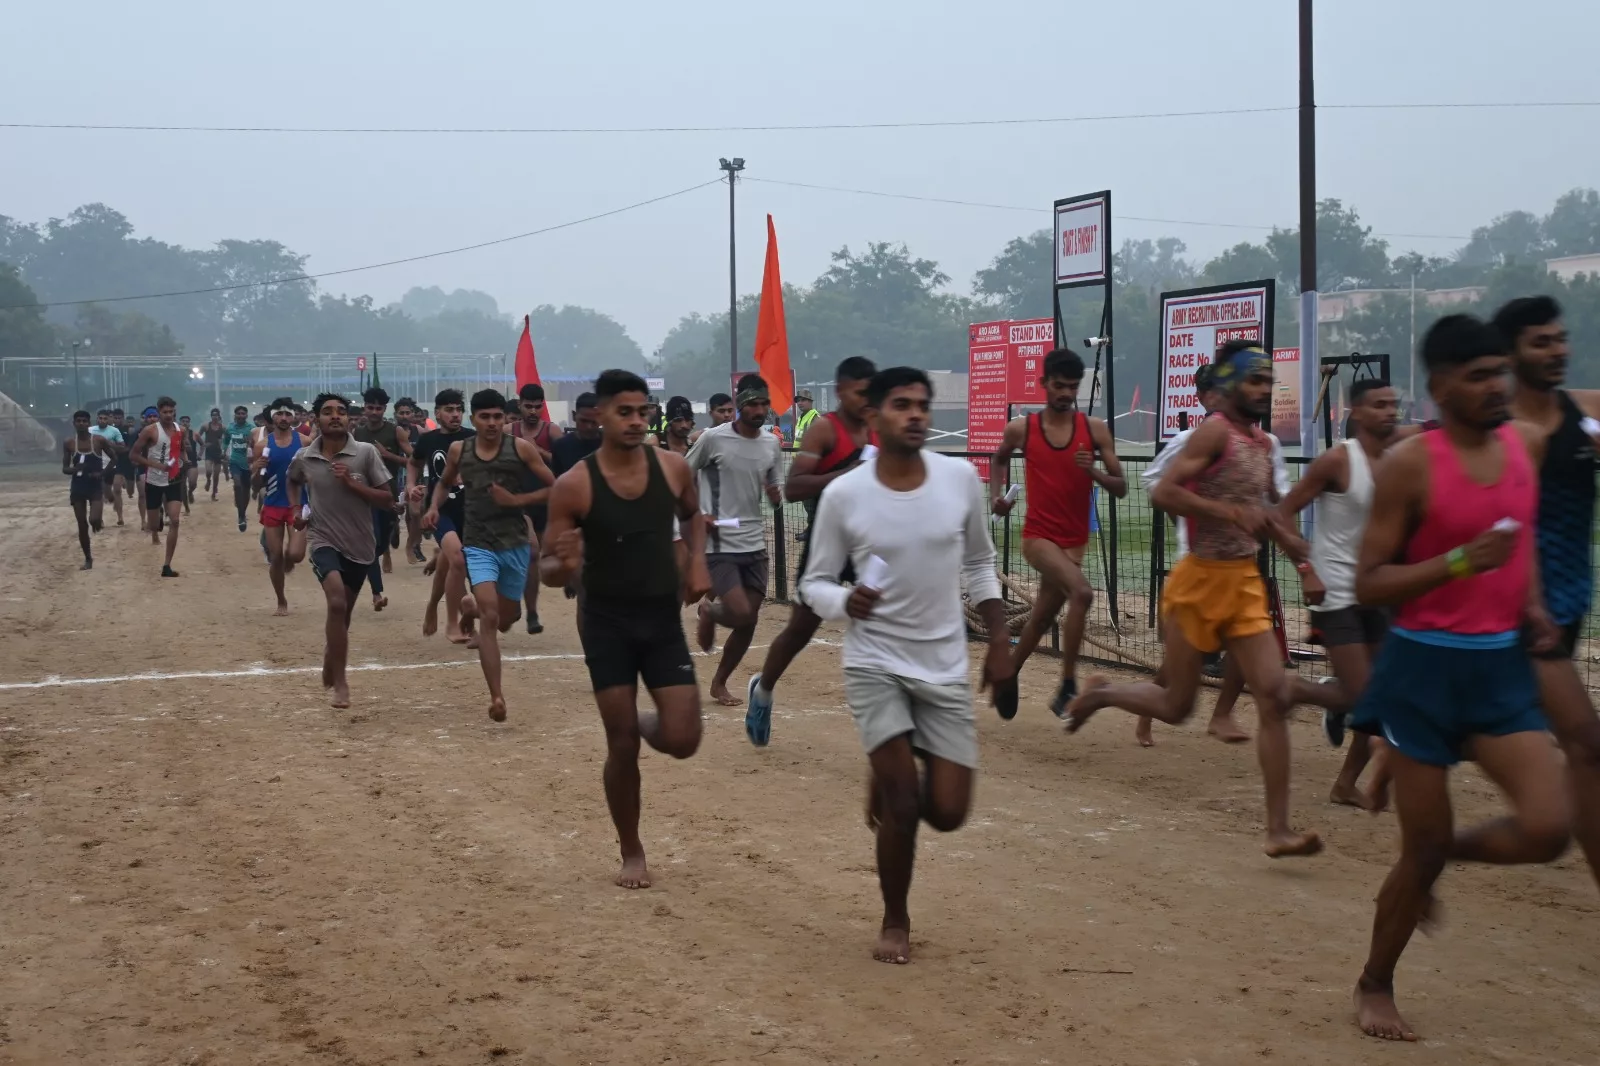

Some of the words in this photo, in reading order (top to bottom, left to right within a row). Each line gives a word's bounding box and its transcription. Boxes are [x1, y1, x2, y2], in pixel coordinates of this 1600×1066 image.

[1172, 308, 1187, 326] ARMY
[1188, 304, 1219, 324] RECRUITING
[1221, 303, 1239, 321] OFFICE
[1240, 300, 1256, 319] AGRA
[1011, 326, 1034, 342] STAND
[1035, 324, 1053, 341] NO-2
[1217, 331, 1227, 344] 08
[1243, 329, 1258, 341] 2023
[1169, 333, 1193, 348] DATE
[1169, 354, 1194, 368] RACE
[1197, 352, 1210, 366] No
[1275, 350, 1297, 361] ARMY
[358, 358, 364, 369] 5
[1025, 359, 1036, 370] RUN
[1168, 374, 1197, 388] ROUN
[1167, 394, 1199, 408] TRADE
[1274, 398, 1297, 406] Soldier
